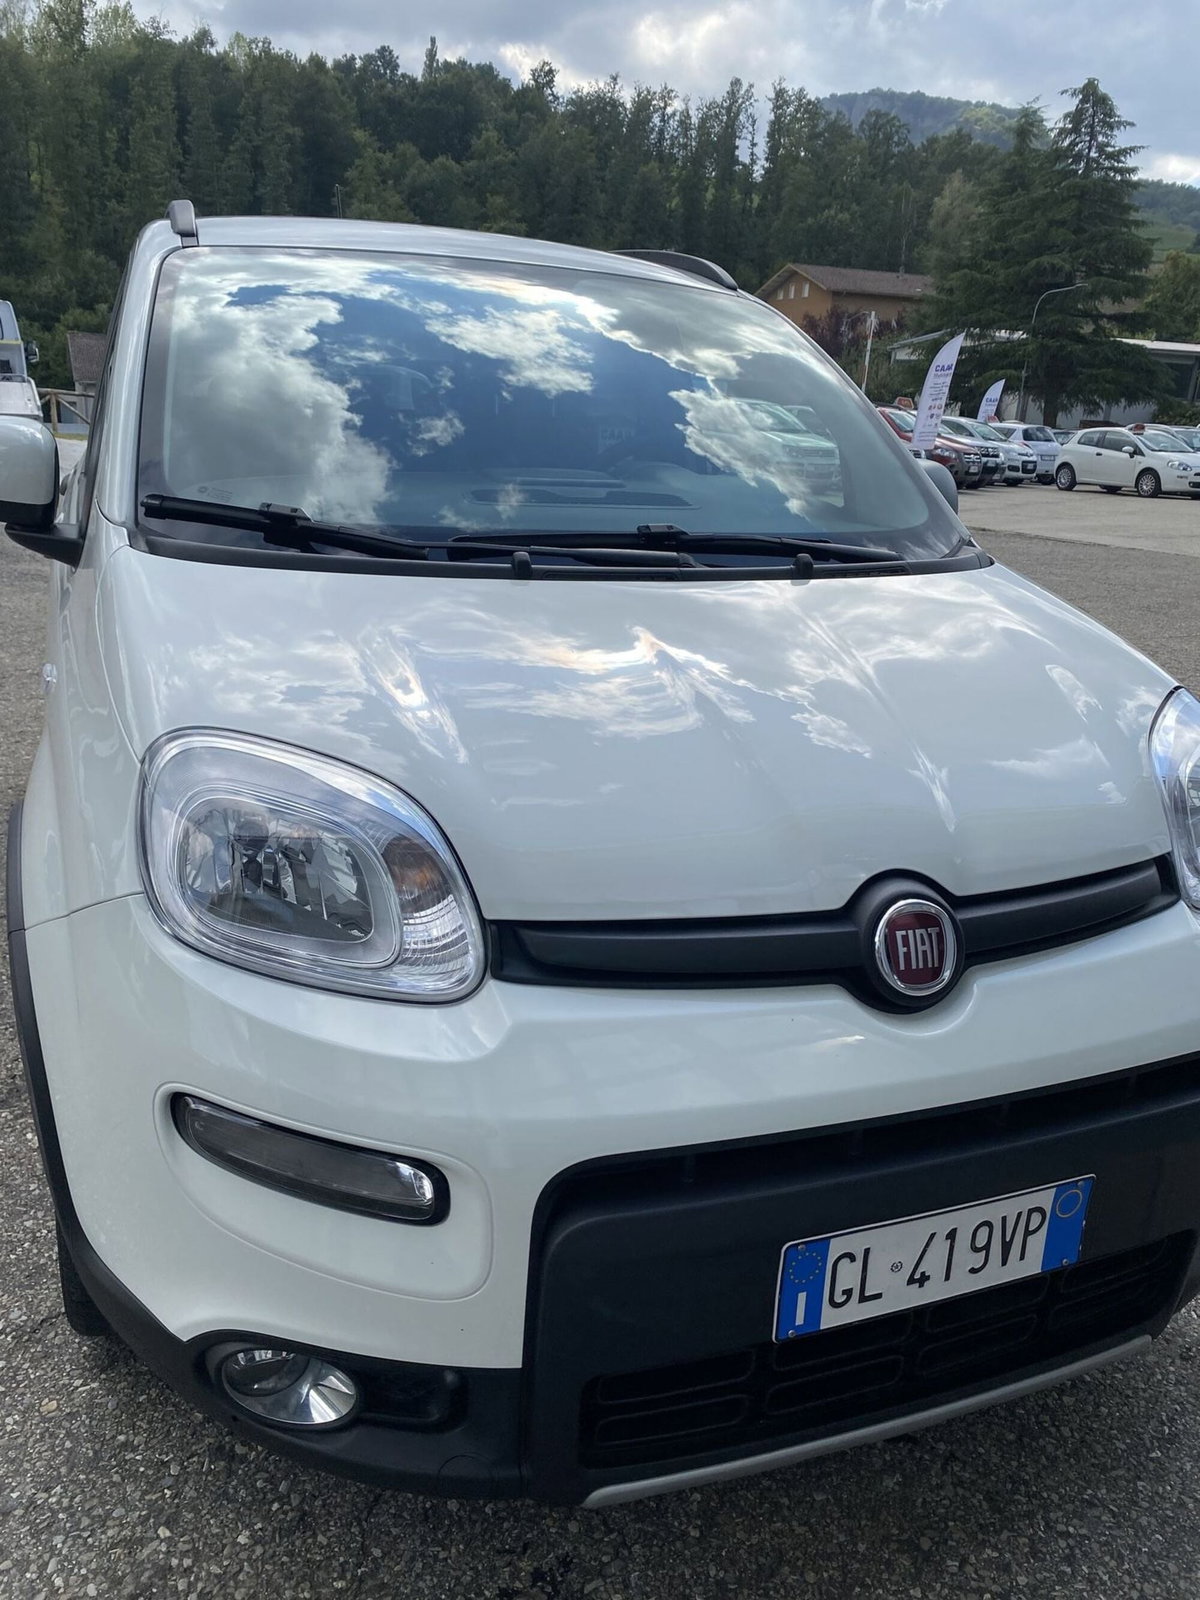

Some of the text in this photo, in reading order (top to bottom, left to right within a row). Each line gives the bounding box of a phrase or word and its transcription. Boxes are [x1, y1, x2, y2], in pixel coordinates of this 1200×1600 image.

[896, 926, 940, 971] FIAT
[828, 1205, 1048, 1310] GL 419VP
